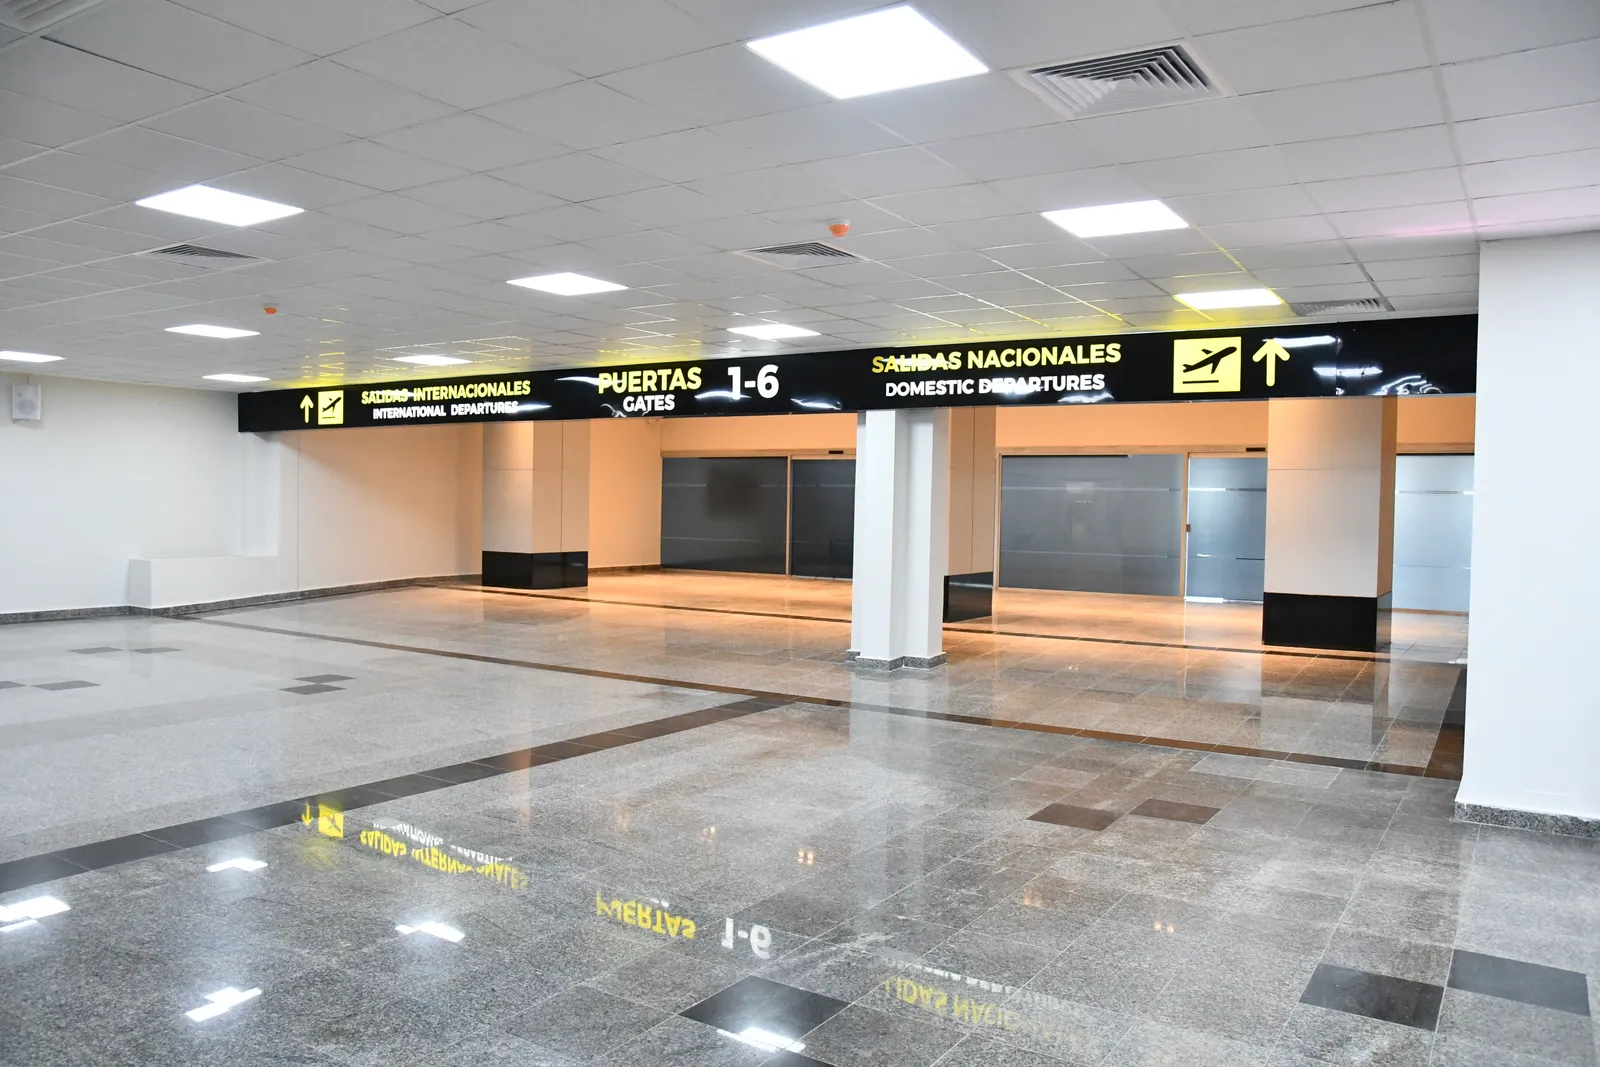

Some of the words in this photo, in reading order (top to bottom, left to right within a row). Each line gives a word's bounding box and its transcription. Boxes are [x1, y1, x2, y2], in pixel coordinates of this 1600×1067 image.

[871, 351, 963, 373] SALIDAS
[967, 342, 1122, 370] NACIONALES
[361, 388, 409, 404] SALIDAS
[413, 380, 531, 402] INTERNACIONALES
[597, 366, 702, 394] PUERTAS
[727, 364, 780, 400] 1-6
[885, 378, 975, 397] DOMESTIC
[978, 373, 1106, 394] DEPARTURES
[372, 405, 447, 419] INTERNATIONAL
[450, 401, 519, 416] DEPARTURES
[622, 394, 676, 412] GATES
